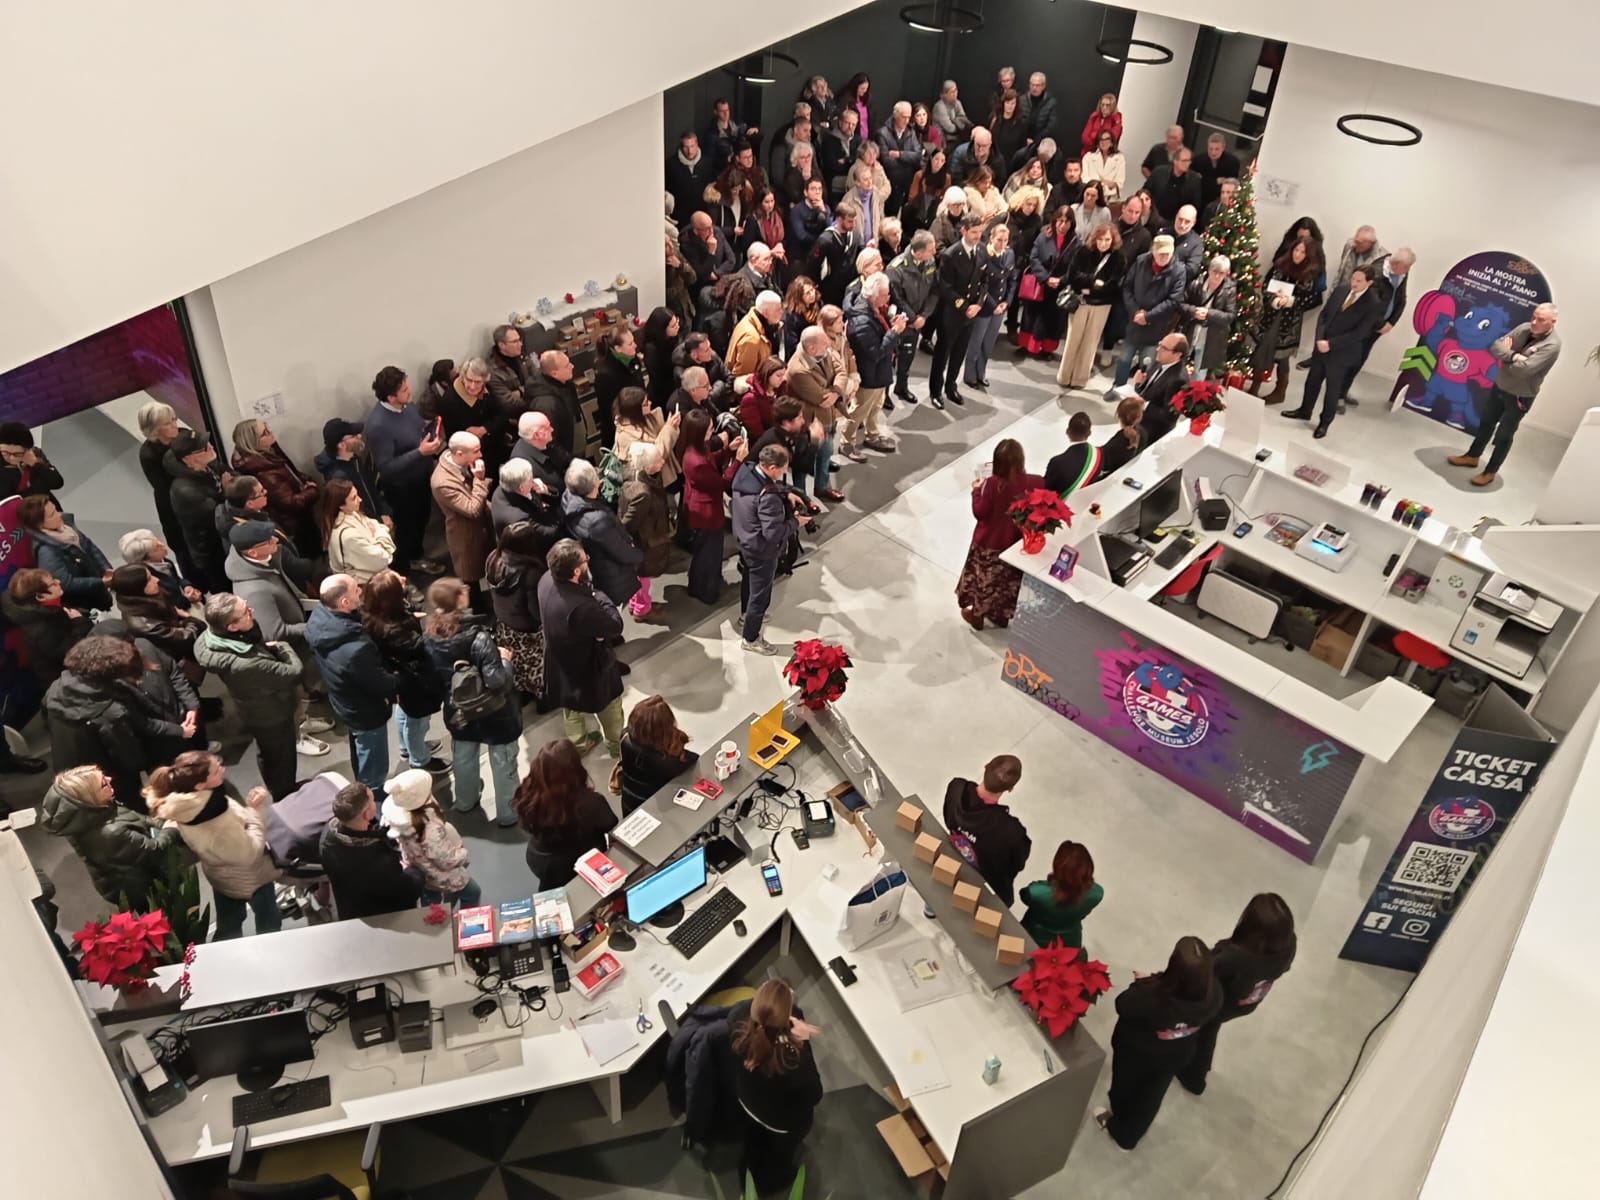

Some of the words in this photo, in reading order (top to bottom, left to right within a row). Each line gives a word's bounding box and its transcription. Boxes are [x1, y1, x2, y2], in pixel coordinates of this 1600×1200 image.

[1468, 268, 1491, 282] INIZIA
[1492, 276, 1502, 286] AL
[1512, 284, 1538, 298] PIANO
[1484, 266, 1494, 274] LA
[1495, 269, 1527, 286] MOSTRA
[1136, 695, 1193, 724] GAMES
[1147, 728, 1184, 745] MUSEUM
[1186, 718, 1205, 743] JESOLO
[1454, 749, 1537, 776] TICKET
[1443, 766, 1523, 792] CASSA
[1380, 902, 1399, 911] SUI
[1400, 906, 1438, 918] SOCIAL
[1392, 897, 1434, 910] SEGUICI
